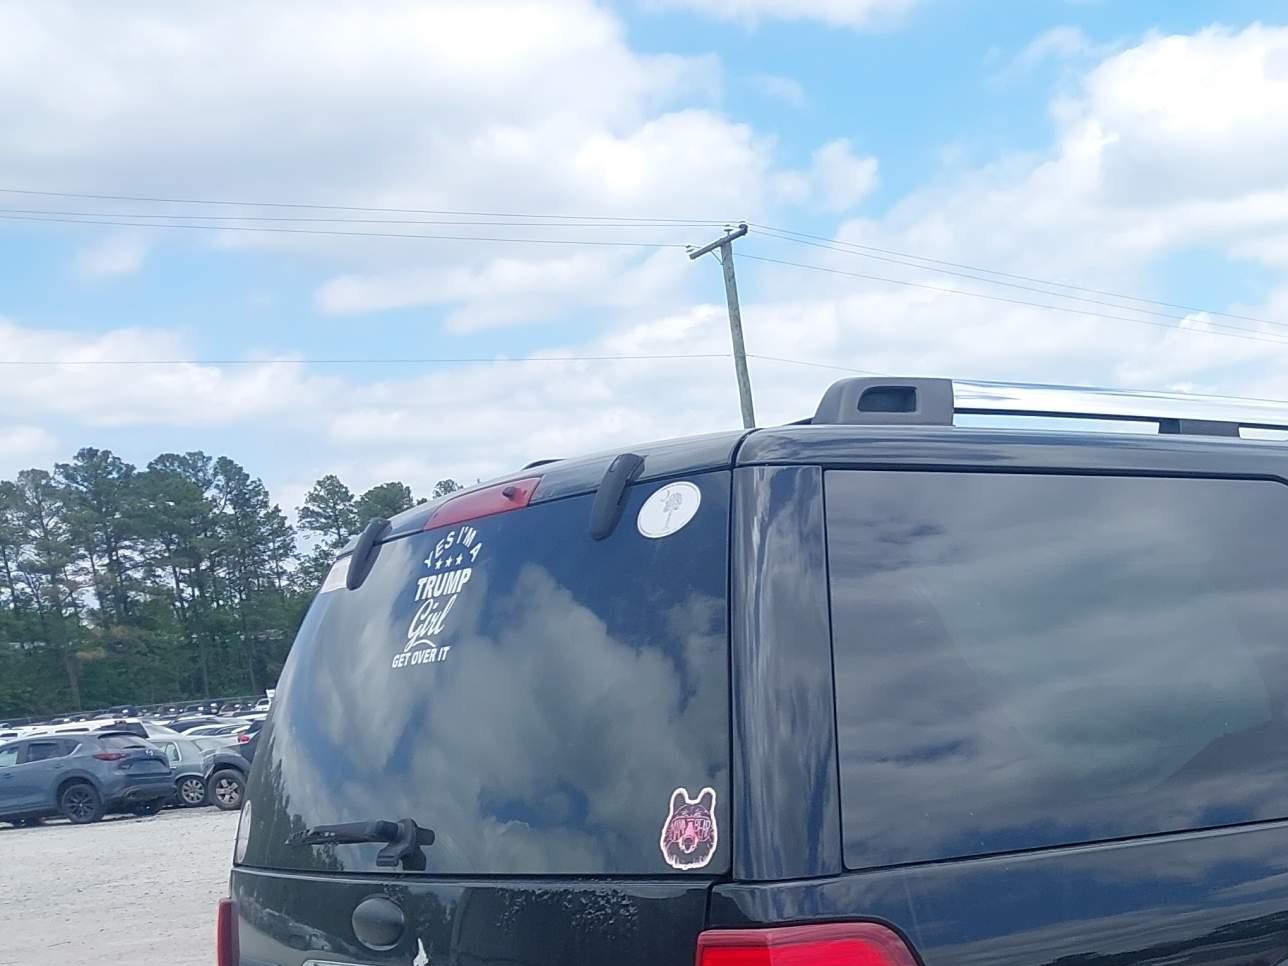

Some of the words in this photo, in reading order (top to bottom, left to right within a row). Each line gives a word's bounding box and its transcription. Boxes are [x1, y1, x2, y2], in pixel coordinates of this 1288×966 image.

[424, 530, 455, 568] YES
[457, 526, 477, 547] I'M
[470, 542, 482, 562] A
[415, 568, 472, 601] TRUMP
[404, 594, 458, 652] Girl
[392, 651, 411, 668] GET
[411, 647, 437, 665] OVER
[438, 646, 451, 661] IT
